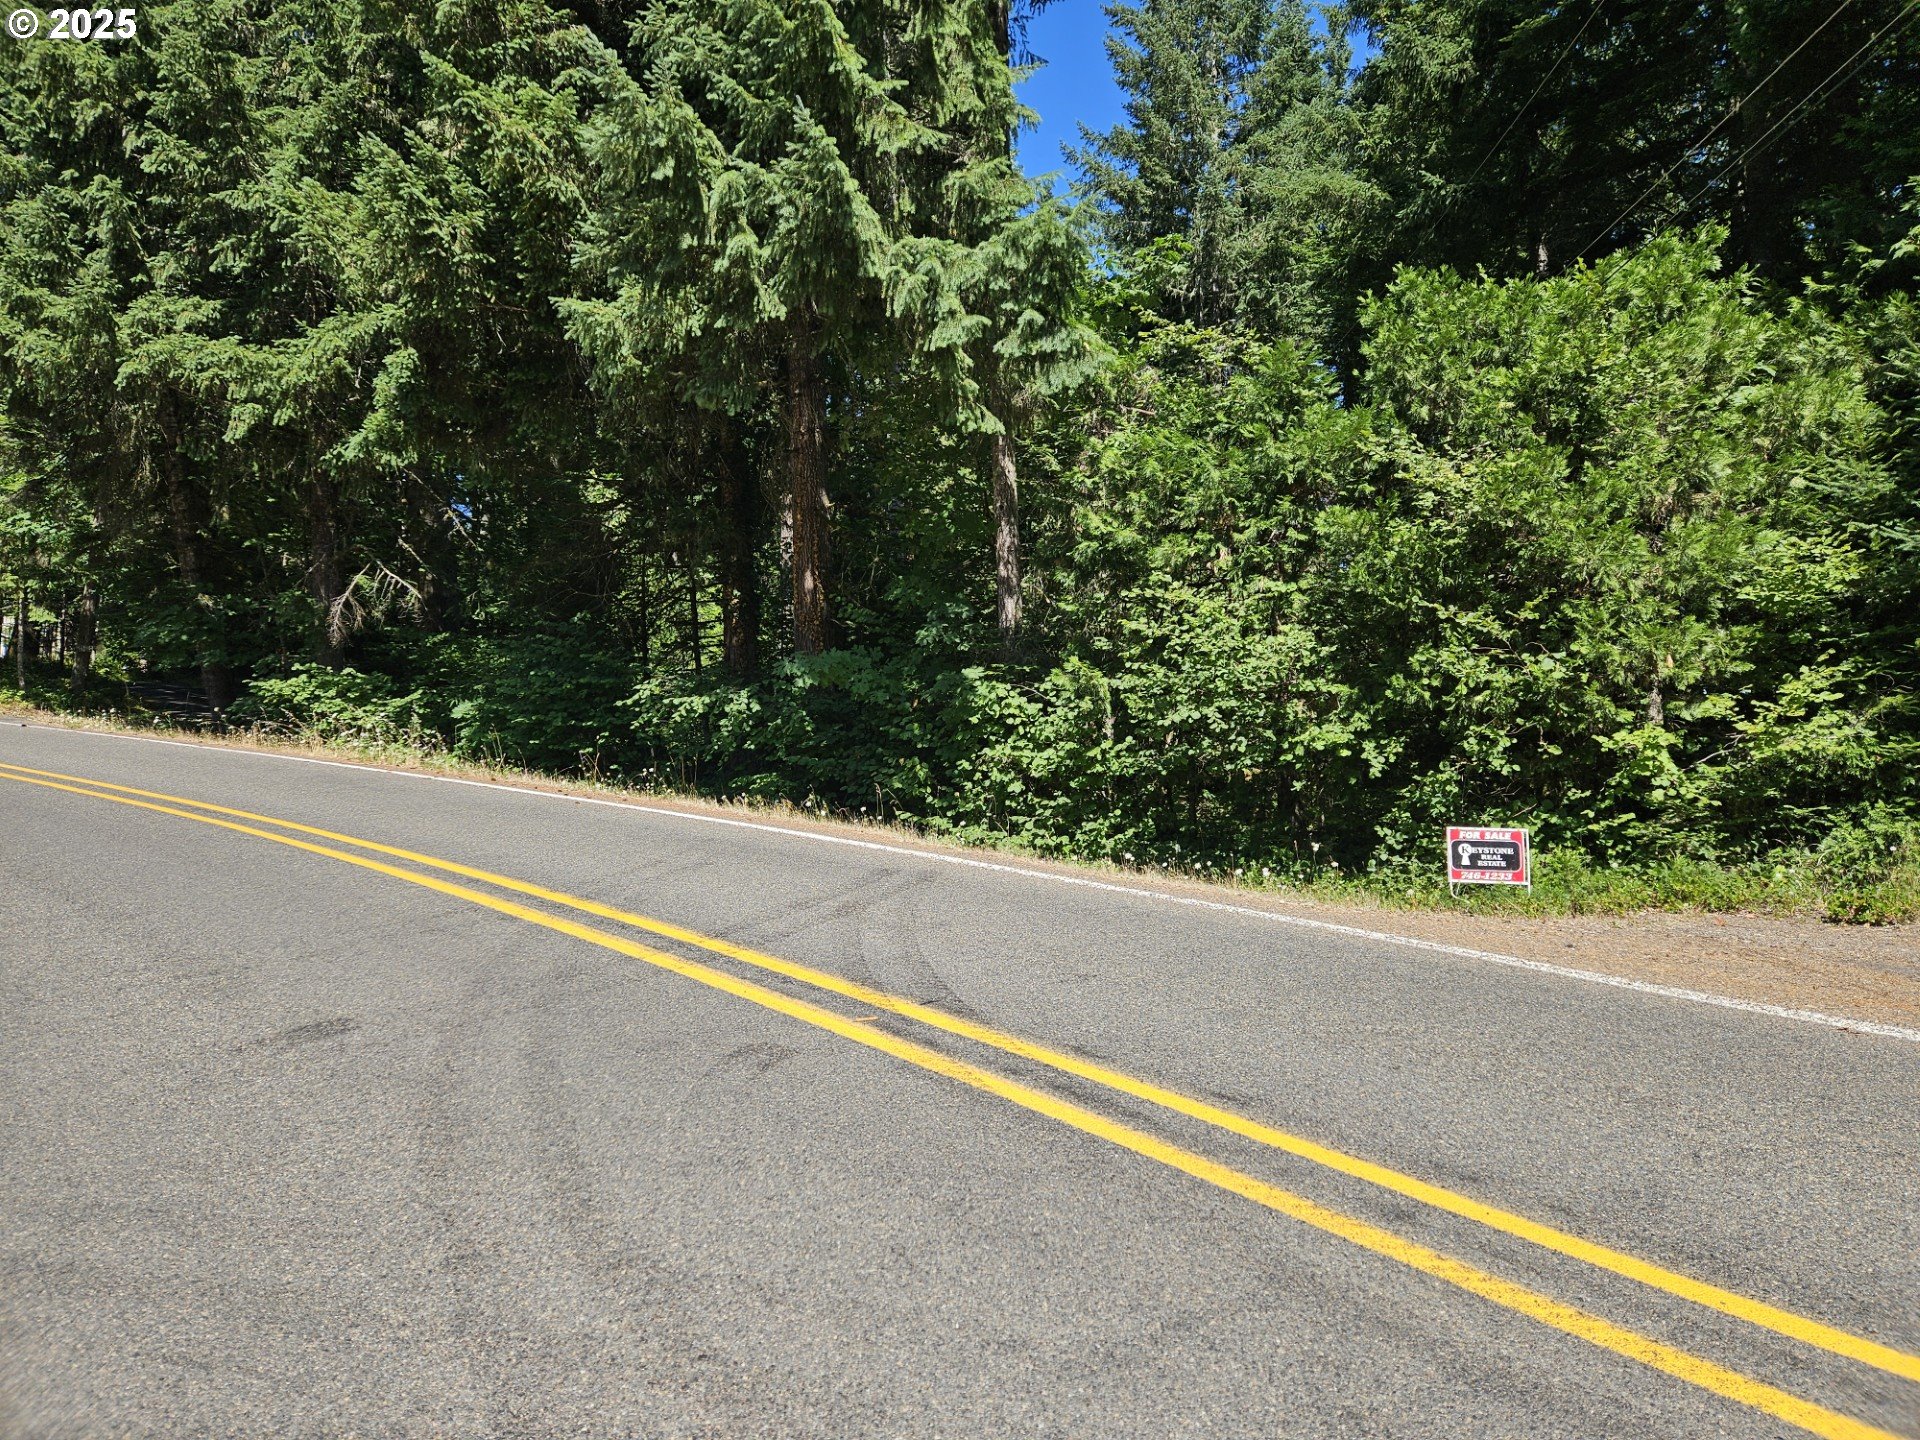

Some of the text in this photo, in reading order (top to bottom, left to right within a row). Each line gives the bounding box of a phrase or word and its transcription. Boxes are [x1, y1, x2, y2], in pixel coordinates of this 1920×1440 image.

[1459, 831, 1512, 840] FOR SALE
[1461, 846, 1514, 855] KEYSTONE
